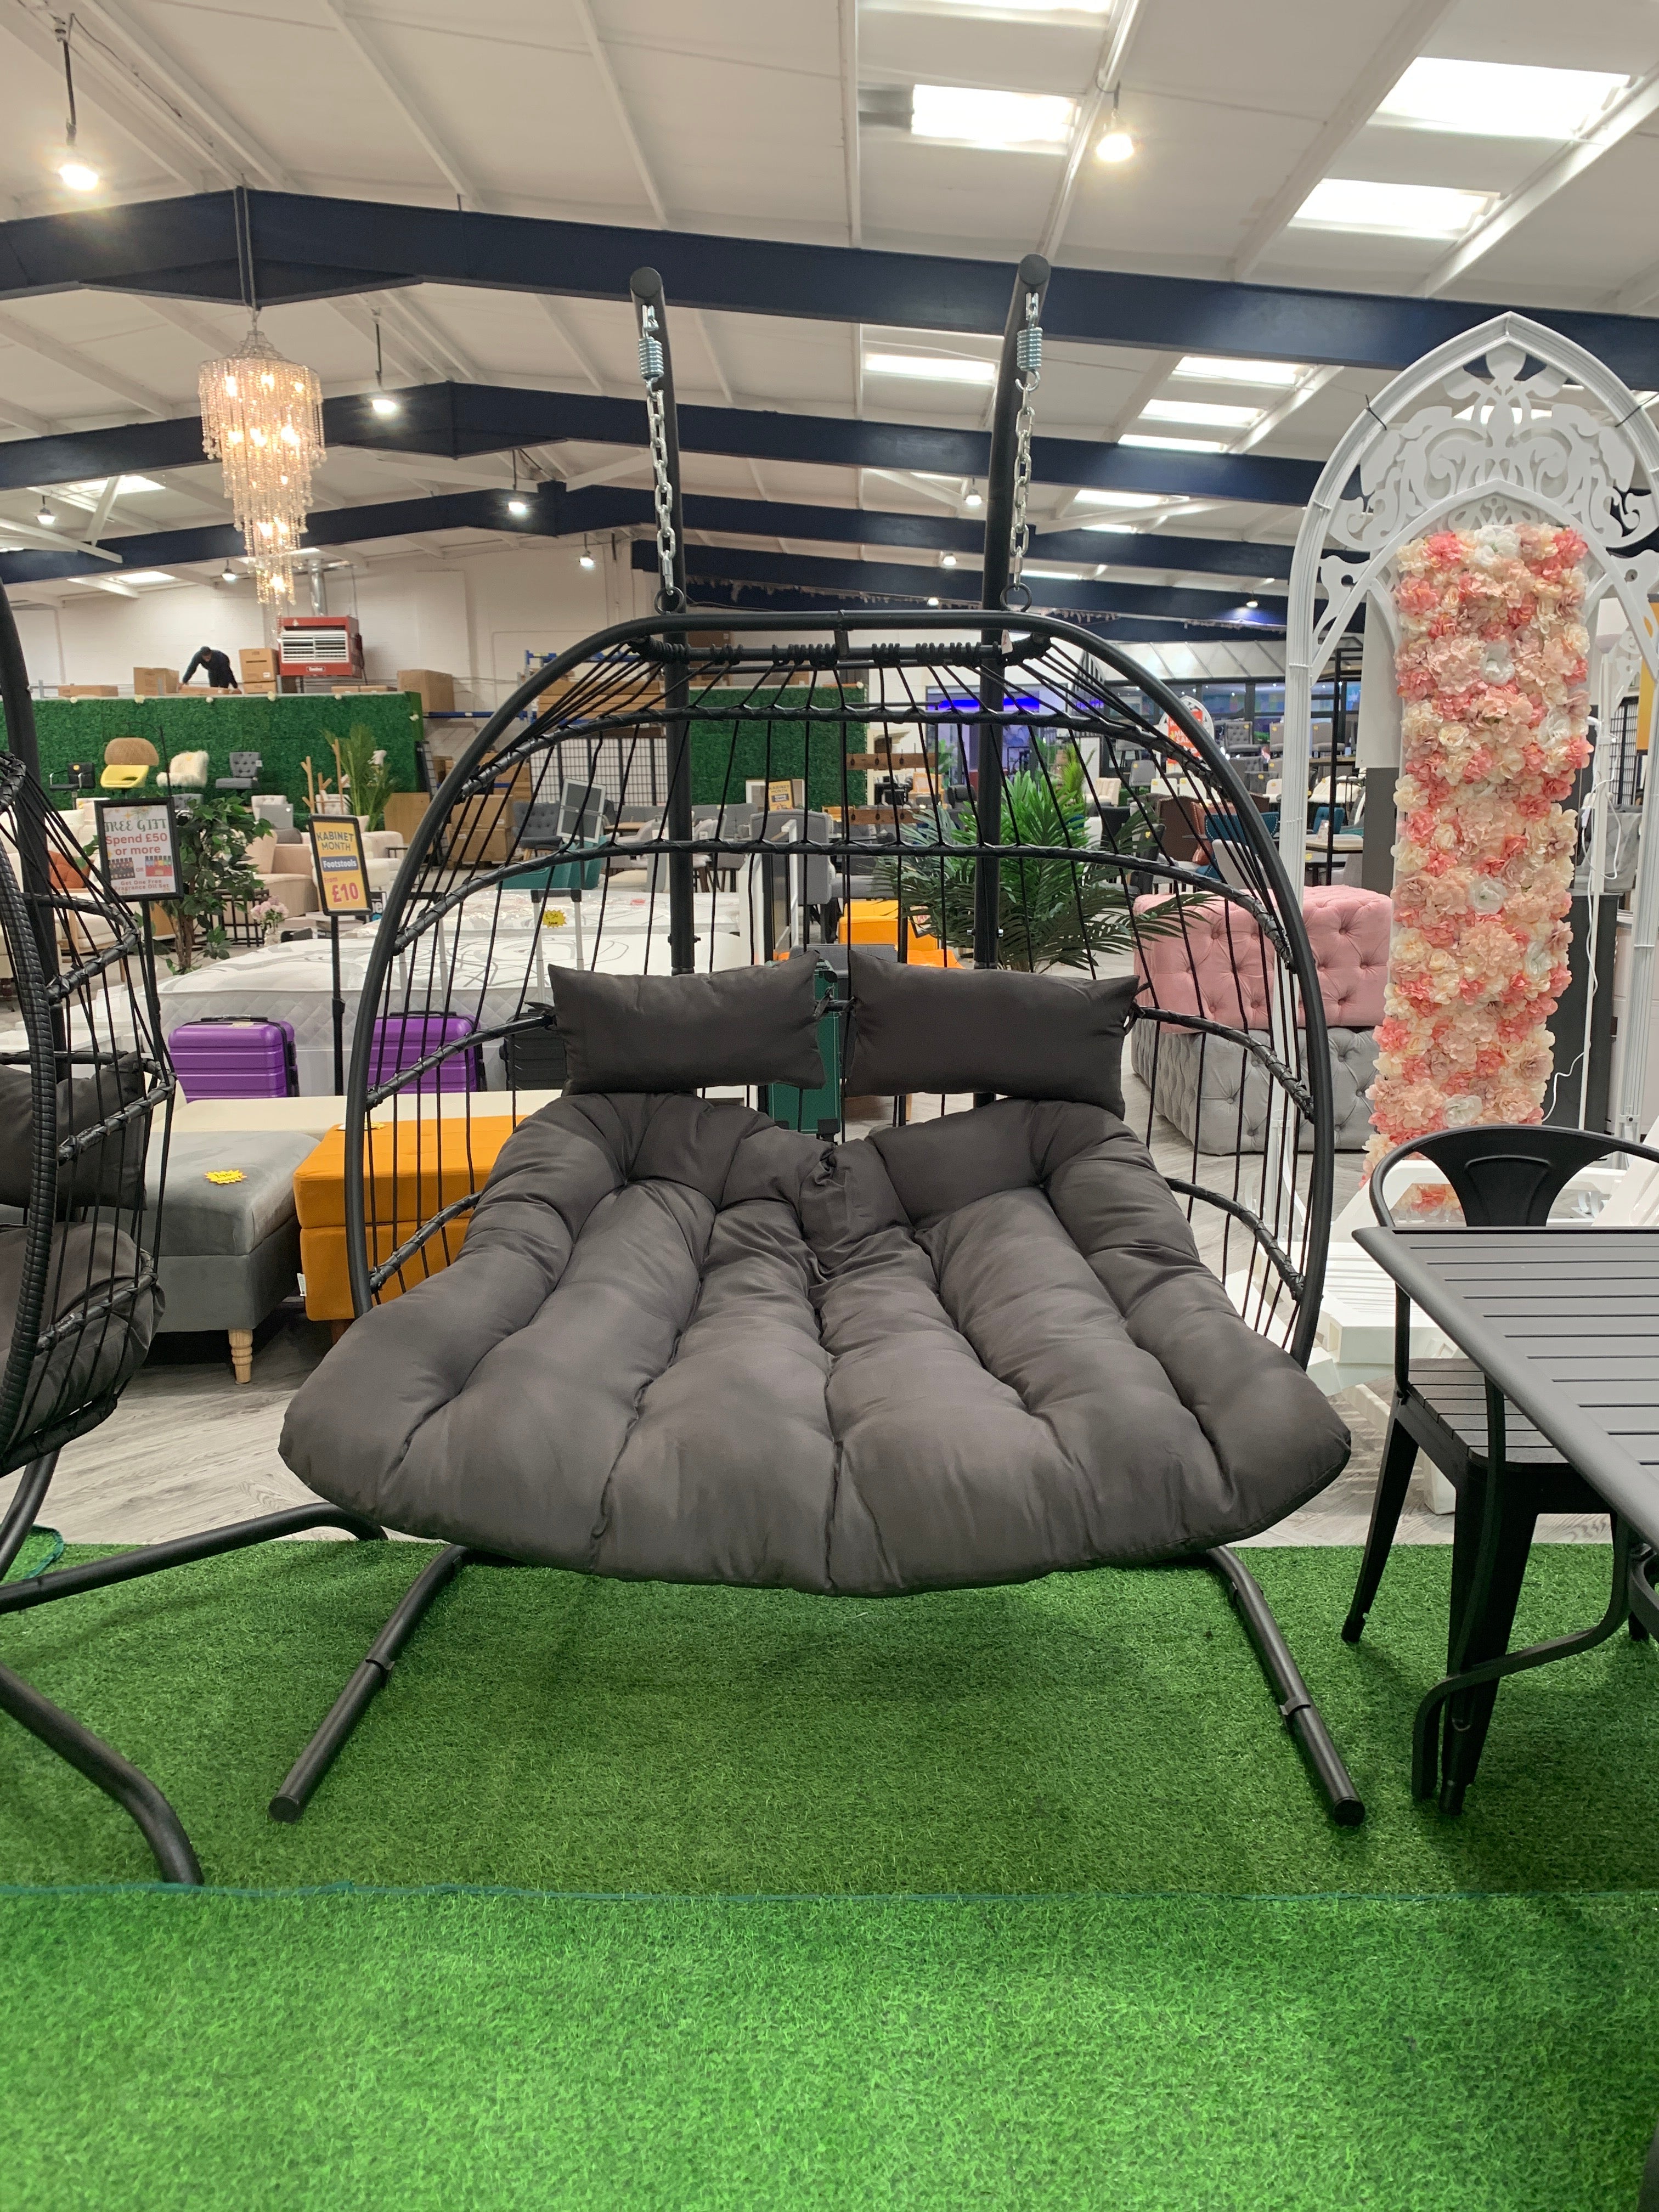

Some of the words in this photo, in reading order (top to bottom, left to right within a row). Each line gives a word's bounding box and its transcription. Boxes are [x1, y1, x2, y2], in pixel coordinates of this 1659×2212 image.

[137, 819, 166, 832] GIFT
[105, 834, 143, 846] Spend
[145, 833, 167, 842] £50
[317, 831, 354, 842] KABINET
[131, 847, 161, 855] more
[321, 842, 351, 851] MONTH
[323, 859, 357, 868] Footstools
[332, 882, 359, 903] £10
